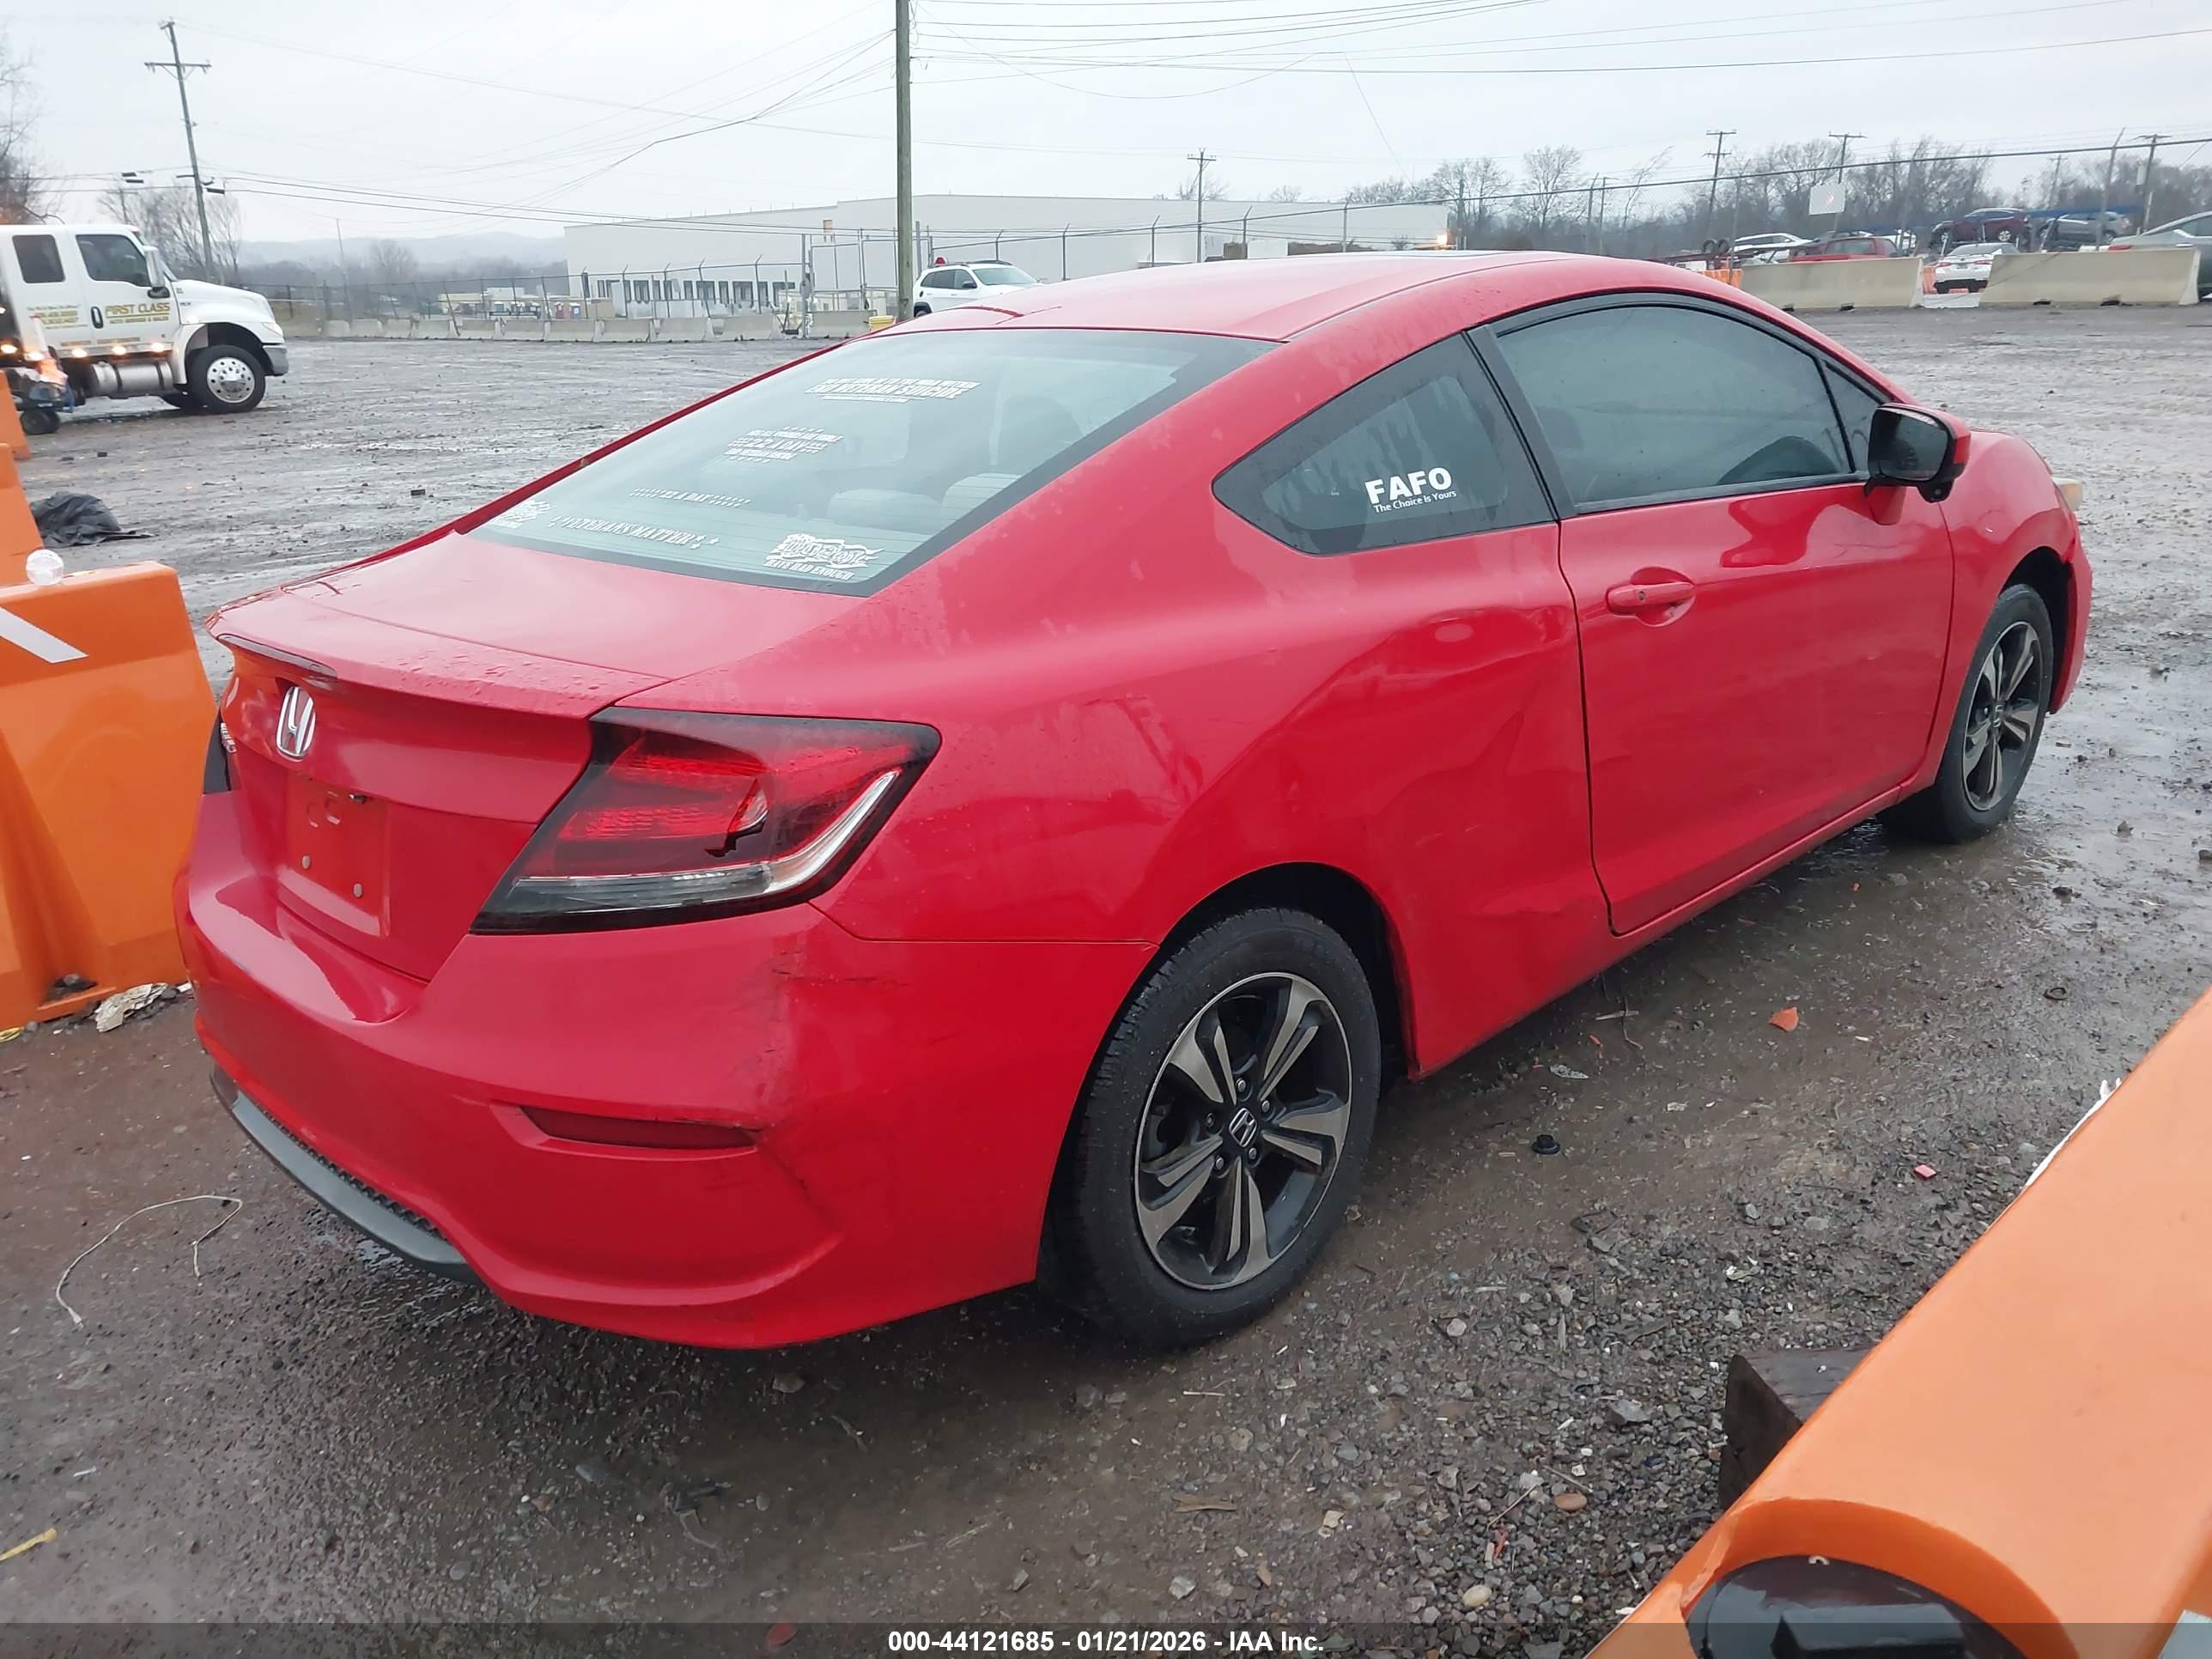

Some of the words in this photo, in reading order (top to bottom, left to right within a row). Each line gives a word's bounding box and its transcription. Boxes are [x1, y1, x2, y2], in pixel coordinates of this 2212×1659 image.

[105, 304, 135, 316] FIRST
[138, 302, 171, 313] CLASS
[890, 384, 969, 399] SUICIDE
[1364, 467, 1452, 505] FAFO
[1373, 503, 1392, 514] The
[1392, 497, 1423, 509] Choice
[1424, 495, 1432, 503] Is
[1431, 490, 1457, 501] Yours
[627, 523, 696, 545] MATTER
[810, 565, 856, 580] ENOUGH
